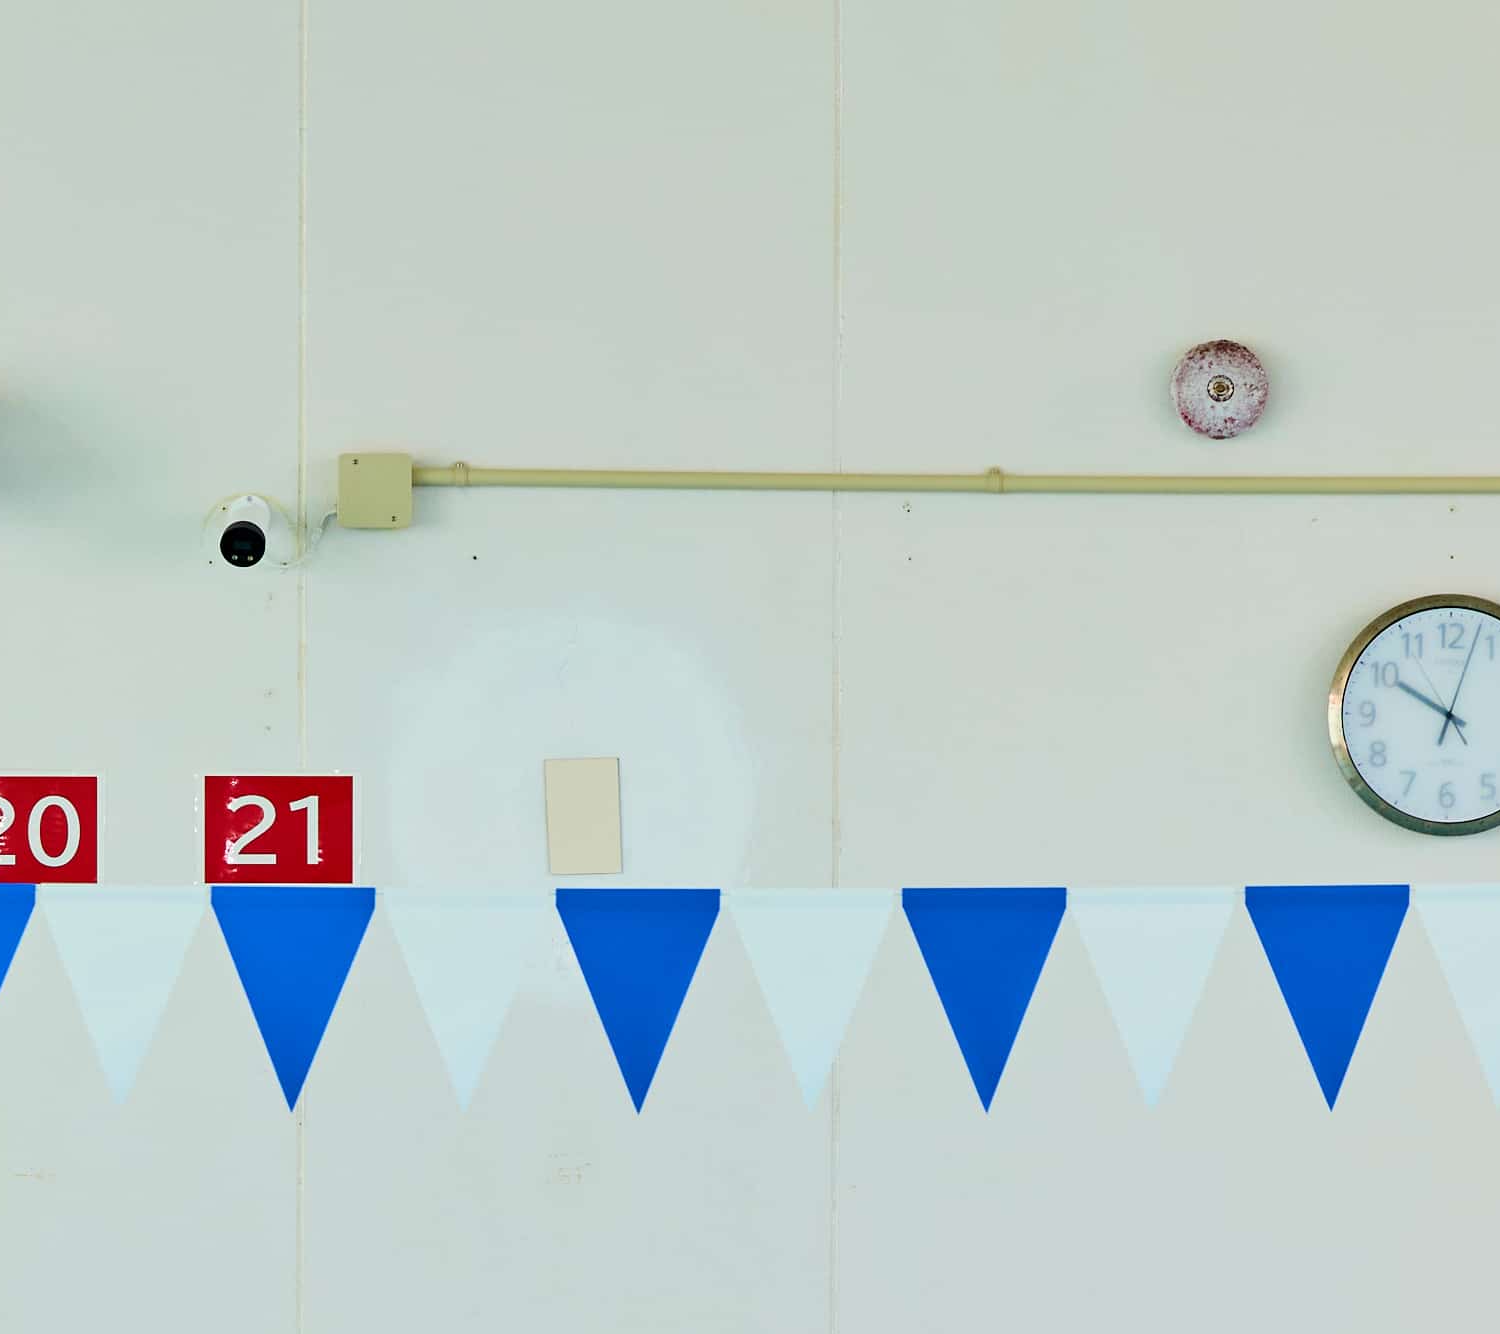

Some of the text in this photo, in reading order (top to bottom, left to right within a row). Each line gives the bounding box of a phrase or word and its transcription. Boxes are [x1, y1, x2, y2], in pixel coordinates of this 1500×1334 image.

[1401, 632, 1424, 659] 11
[1437, 622, 1465, 650] 12
[1485, 635, 1495, 661] 1
[1371, 661, 1399, 689] 10
[1359, 701, 1377, 728] 9
[1369, 741, 1388, 767] 8
[1400, 771, 1417, 798] 7
[1439, 781, 1456, 809] 6
[1480, 773, 1497, 801] 5
[225, 794, 320, 865] 21
